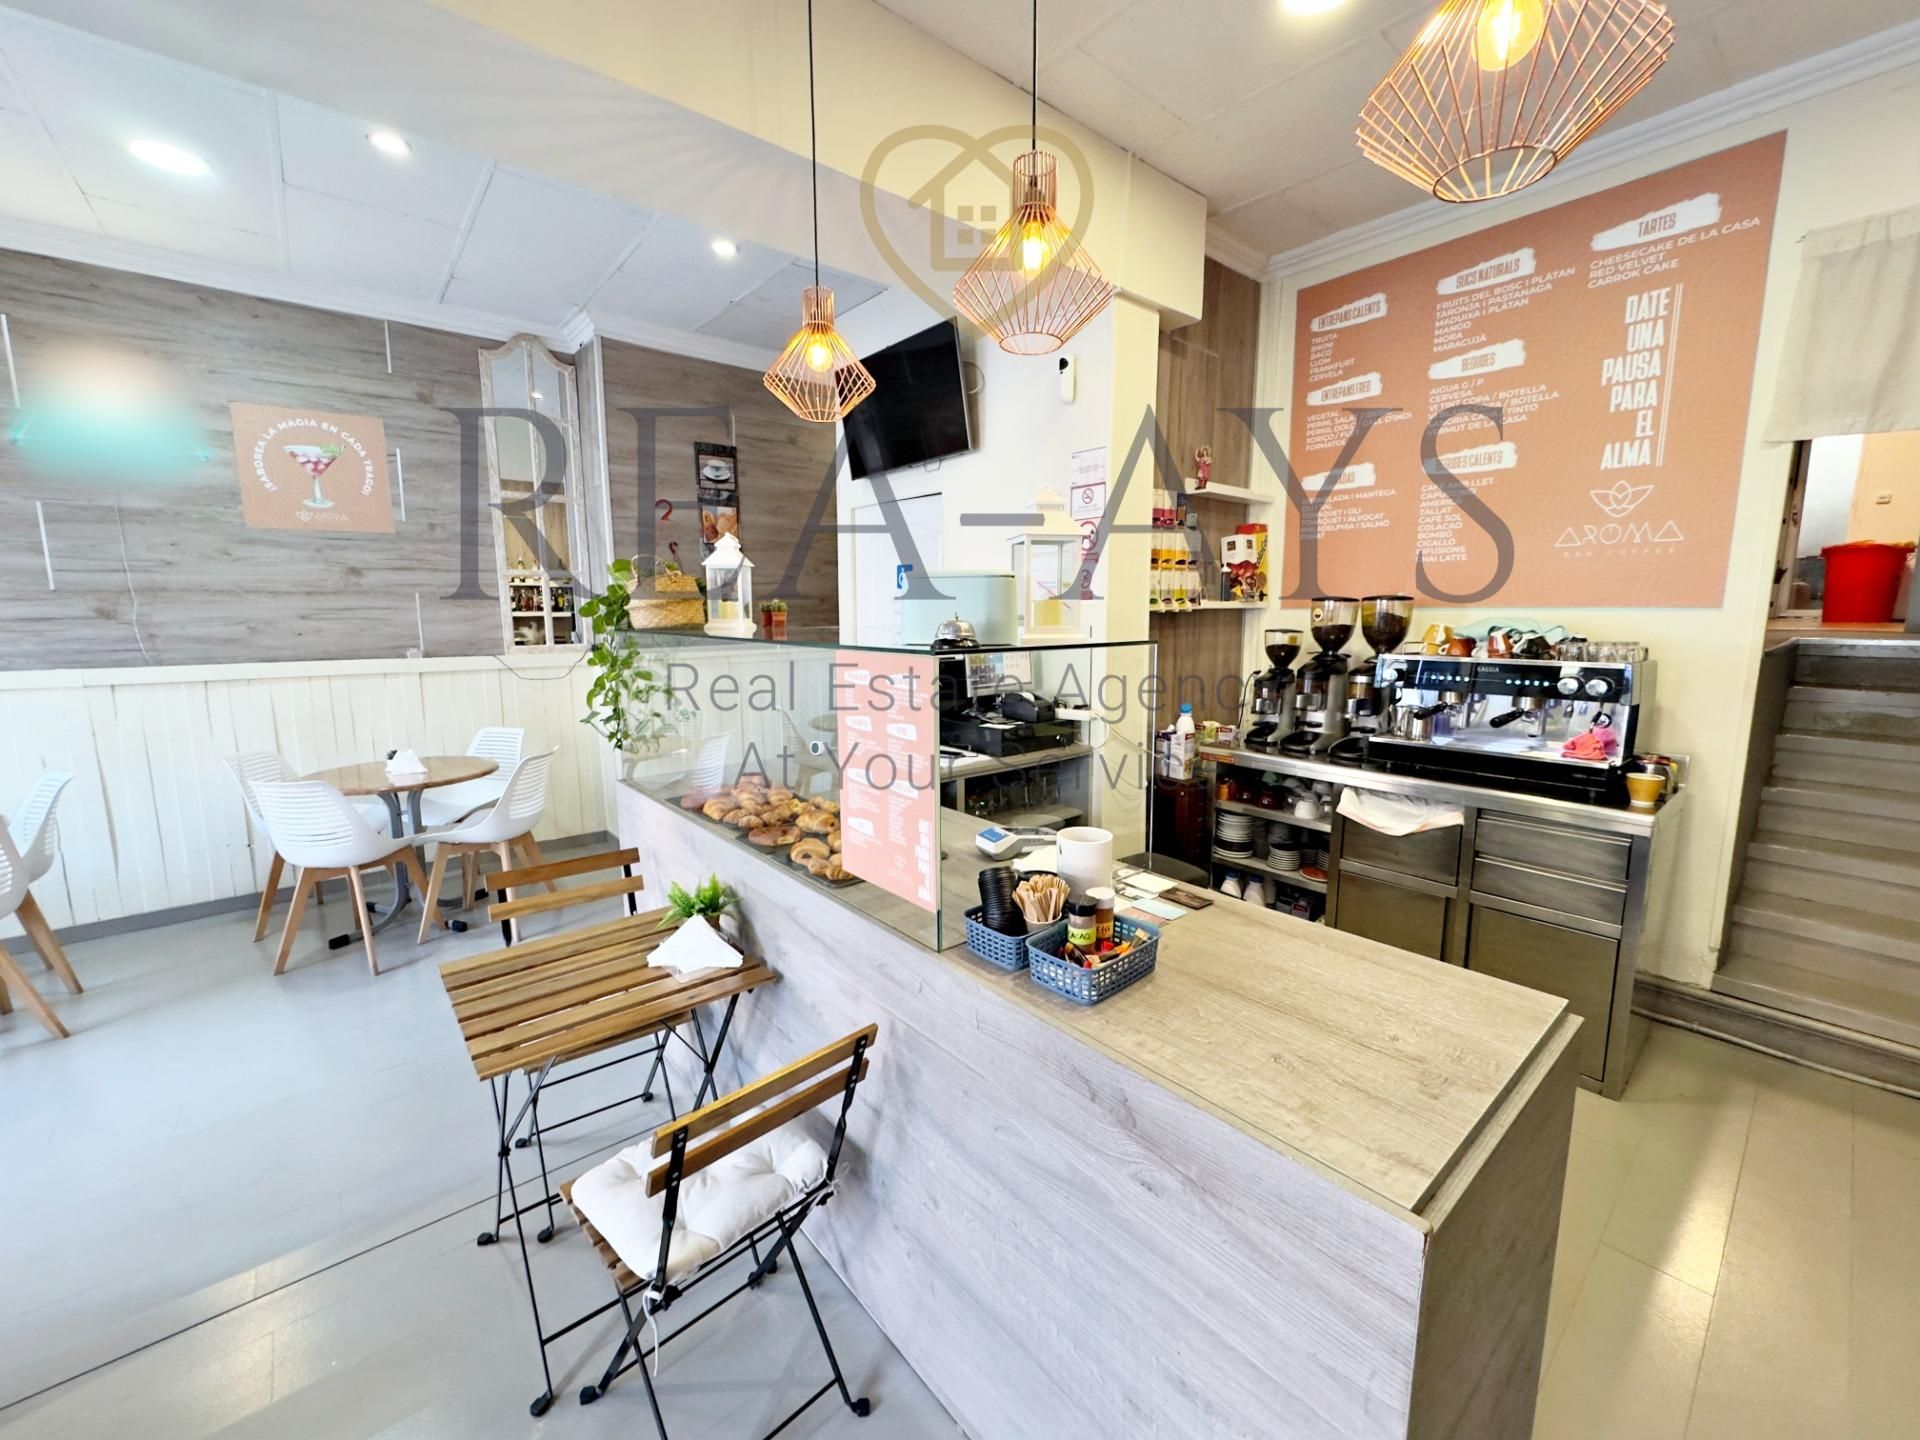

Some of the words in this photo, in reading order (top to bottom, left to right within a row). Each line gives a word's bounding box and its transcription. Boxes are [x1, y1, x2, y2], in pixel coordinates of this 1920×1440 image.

[1638, 212, 1677, 238] TARTES
[1590, 240, 1673, 269] CHEESECAKE
[1677, 233, 1696, 246] DE
[1700, 229, 1719, 240] LA
[1721, 216, 1760, 234] CASA
[1456, 270, 1477, 289] SUCS
[1478, 258, 1520, 283] NATURALS
[1589, 267, 1615, 279] RED
[1618, 252, 1666, 271] VELVET
[1643, 258, 1679, 275] CAKE
[1352, 300, 1381, 319] CALENTS
[1436, 295, 1470, 311] FRUITS
[1472, 290, 1491, 301] DEL
[1494, 281, 1523, 294] BOSC
[1436, 302, 1480, 319] TARONJA
[1487, 282, 1552, 304] PASTANAGA
[1624, 286, 1672, 324] DATE
[1434, 321, 1472, 336] MANGO
[1435, 311, 1480, 328] MADUIXA
[1434, 332, 1463, 344] MORA
[1626, 319, 1664, 353] UNA
[1461, 352, 1495, 371] BEGUDES
[1601, 349, 1661, 387] PAUSA
[1429, 389, 1472, 404] CERVESA
[1430, 383, 1460, 396] AIGUA
[1462, 394, 1490, 407] COPA
[1499, 384, 1547, 399] BOTELLA
[1510, 391, 1559, 406] BOTELLA
[1609, 379, 1658, 413] PARA
[1508, 403, 1538, 415] TINTO
[1635, 409, 1654, 438] EL
[262, 428, 277, 440] LA
[277, 418, 318, 430] MAGIA
[321, 421, 338, 434] EN
[340, 431, 367, 458] CADA
[1600, 439, 1651, 470] ALMA
[1555, 520, 1685, 547] AROMA
